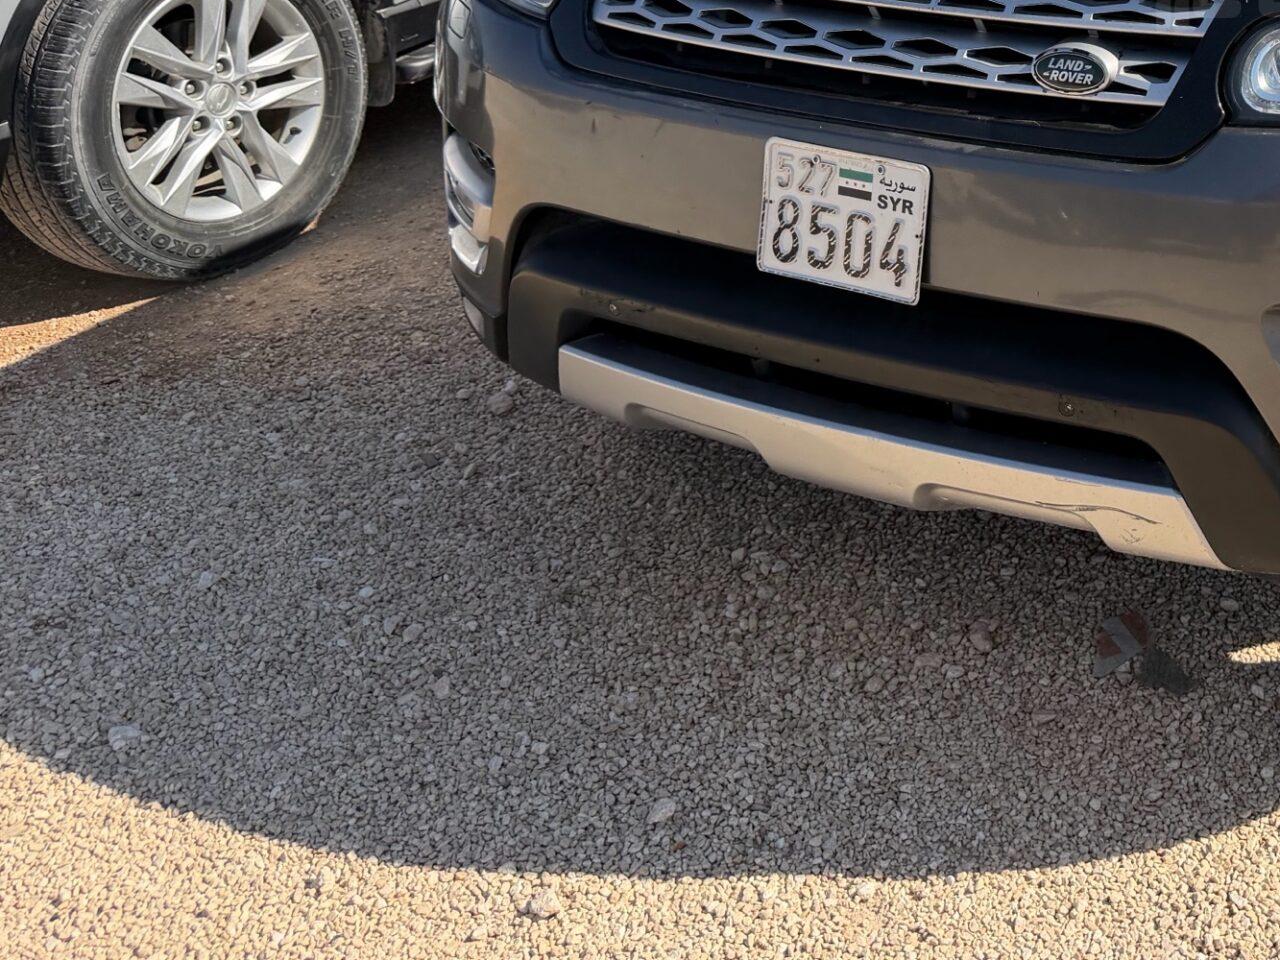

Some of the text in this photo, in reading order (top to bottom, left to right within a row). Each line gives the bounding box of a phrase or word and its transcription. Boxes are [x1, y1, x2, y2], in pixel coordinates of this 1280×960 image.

[777, 152, 837, 197] 527
[877, 194, 914, 216] SYR
[772, 197, 908, 287] 8504
